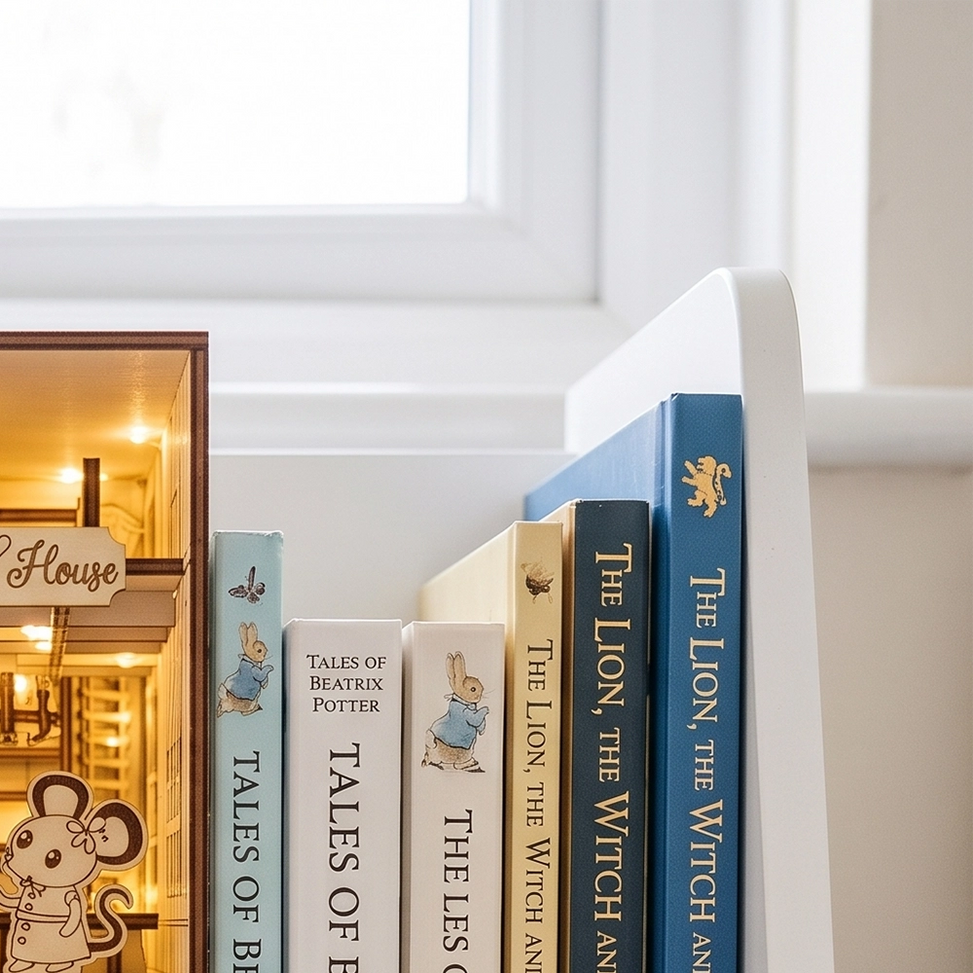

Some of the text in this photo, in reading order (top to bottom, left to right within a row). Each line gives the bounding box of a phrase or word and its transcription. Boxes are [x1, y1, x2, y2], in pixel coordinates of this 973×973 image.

[6, 539, 119, 593] House
[594, 543, 633, 607] THE
[688, 567, 726, 629] THE
[306, 654, 359, 669] TALES
[309, 675, 384, 691] BEATRIX
[526, 638, 554, 692] THE
[590, 617, 632, 716] LION,
[686, 636, 725, 731] LION,
[312, 697, 381, 713] POTTER
[523, 699, 553, 774] LION,
[597, 726, 621, 783] THE
[693, 739, 715, 791] THE
[232, 750, 261, 864] TALES
[327, 742, 360, 873] TALES
[526, 781, 545, 827] THE
[443, 808, 473, 884] THE
[593, 790, 630, 922] WITCH
[688, 798, 724, 923] WITCH
[231, 875, 261, 923] OF
[524, 836, 551, 924] WITCH
[327, 886, 360, 942] OF
[442, 893, 470, 953] LES
